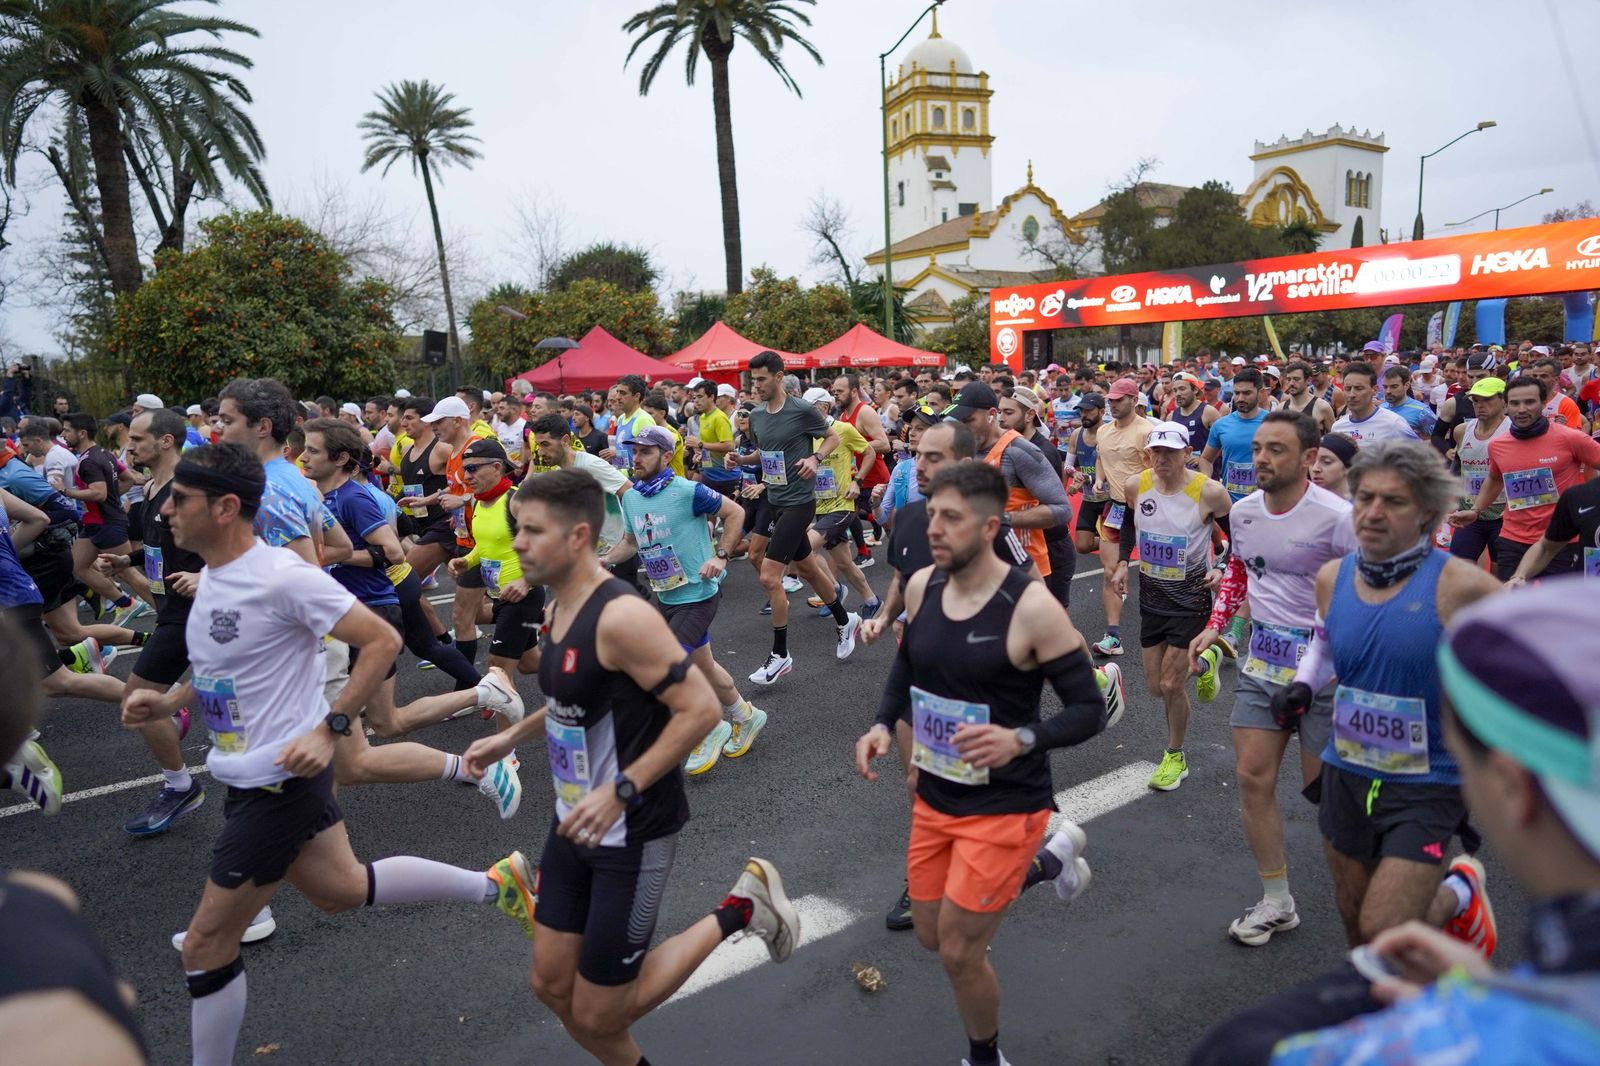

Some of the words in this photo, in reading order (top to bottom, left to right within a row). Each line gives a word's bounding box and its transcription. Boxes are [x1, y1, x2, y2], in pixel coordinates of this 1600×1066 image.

[1470, 247, 1551, 275] HOKA
[1270, 262, 1353, 285] maratón
[1145, 285, 1193, 306] HOKA
[1287, 277, 1355, 299] sevilla
[1231, 470, 1252, 481] 3191
[1471, 480, 1484, 490] 18
[1512, 478, 1542, 493] 3771
[1144, 542, 1173, 560] 3119
[649, 559, 669, 573] 1989
[1257, 634, 1292, 657] 2837
[1349, 710, 1405, 740] 4058
